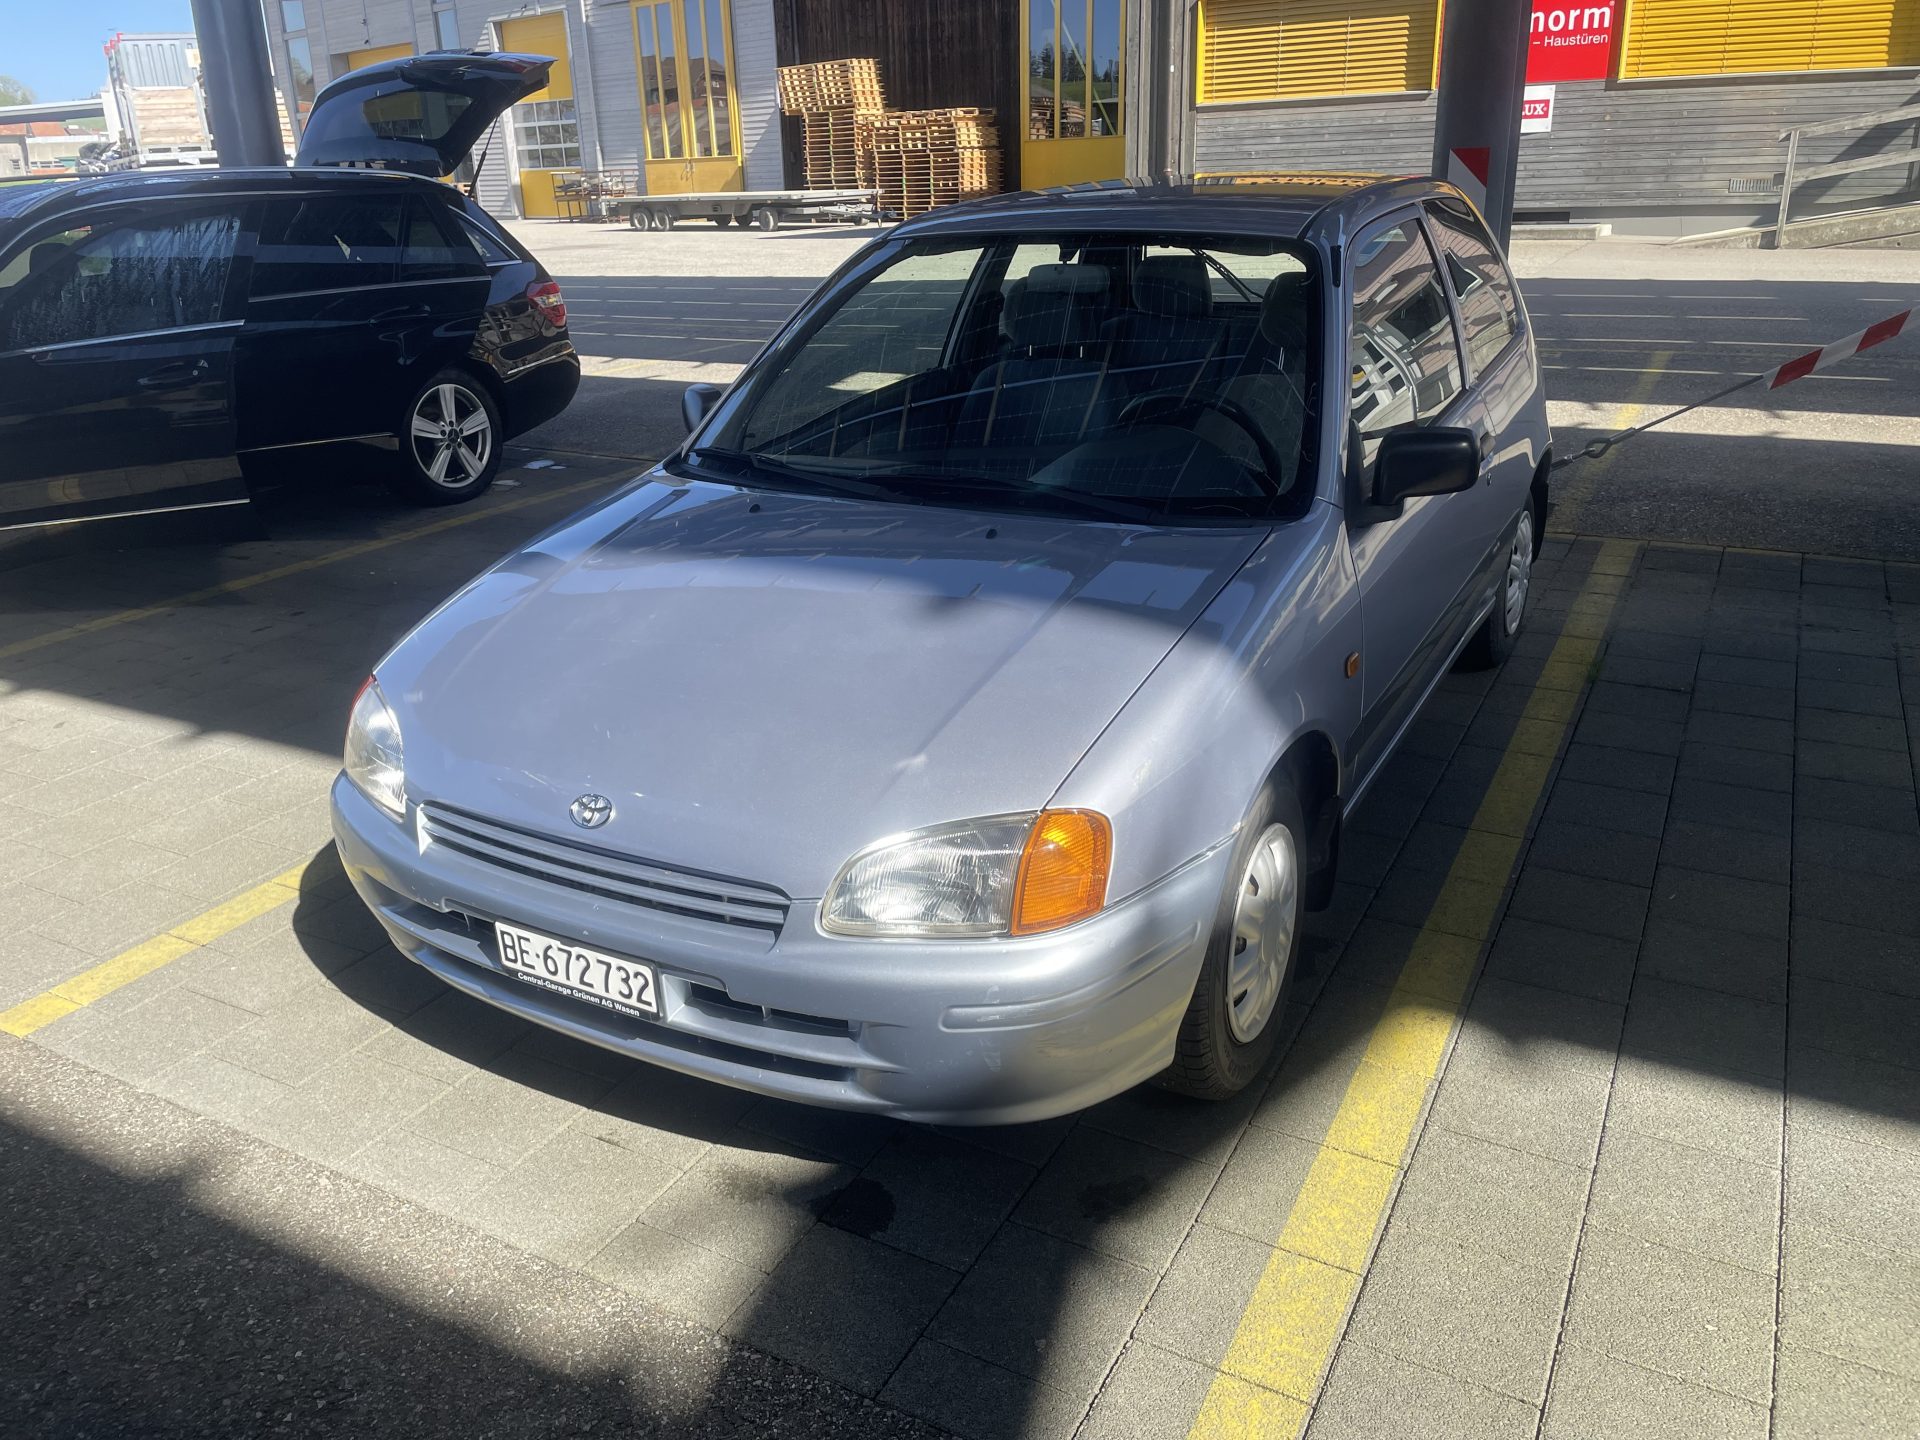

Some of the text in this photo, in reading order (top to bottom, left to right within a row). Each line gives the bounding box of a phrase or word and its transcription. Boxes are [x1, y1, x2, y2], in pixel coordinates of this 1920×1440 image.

[1530, 6, 1611, 33] norm
[1544, 33, 1608, 47] Haustüren
[517, 972, 640, 1017] Central-Garage Grünen AG Wasen
